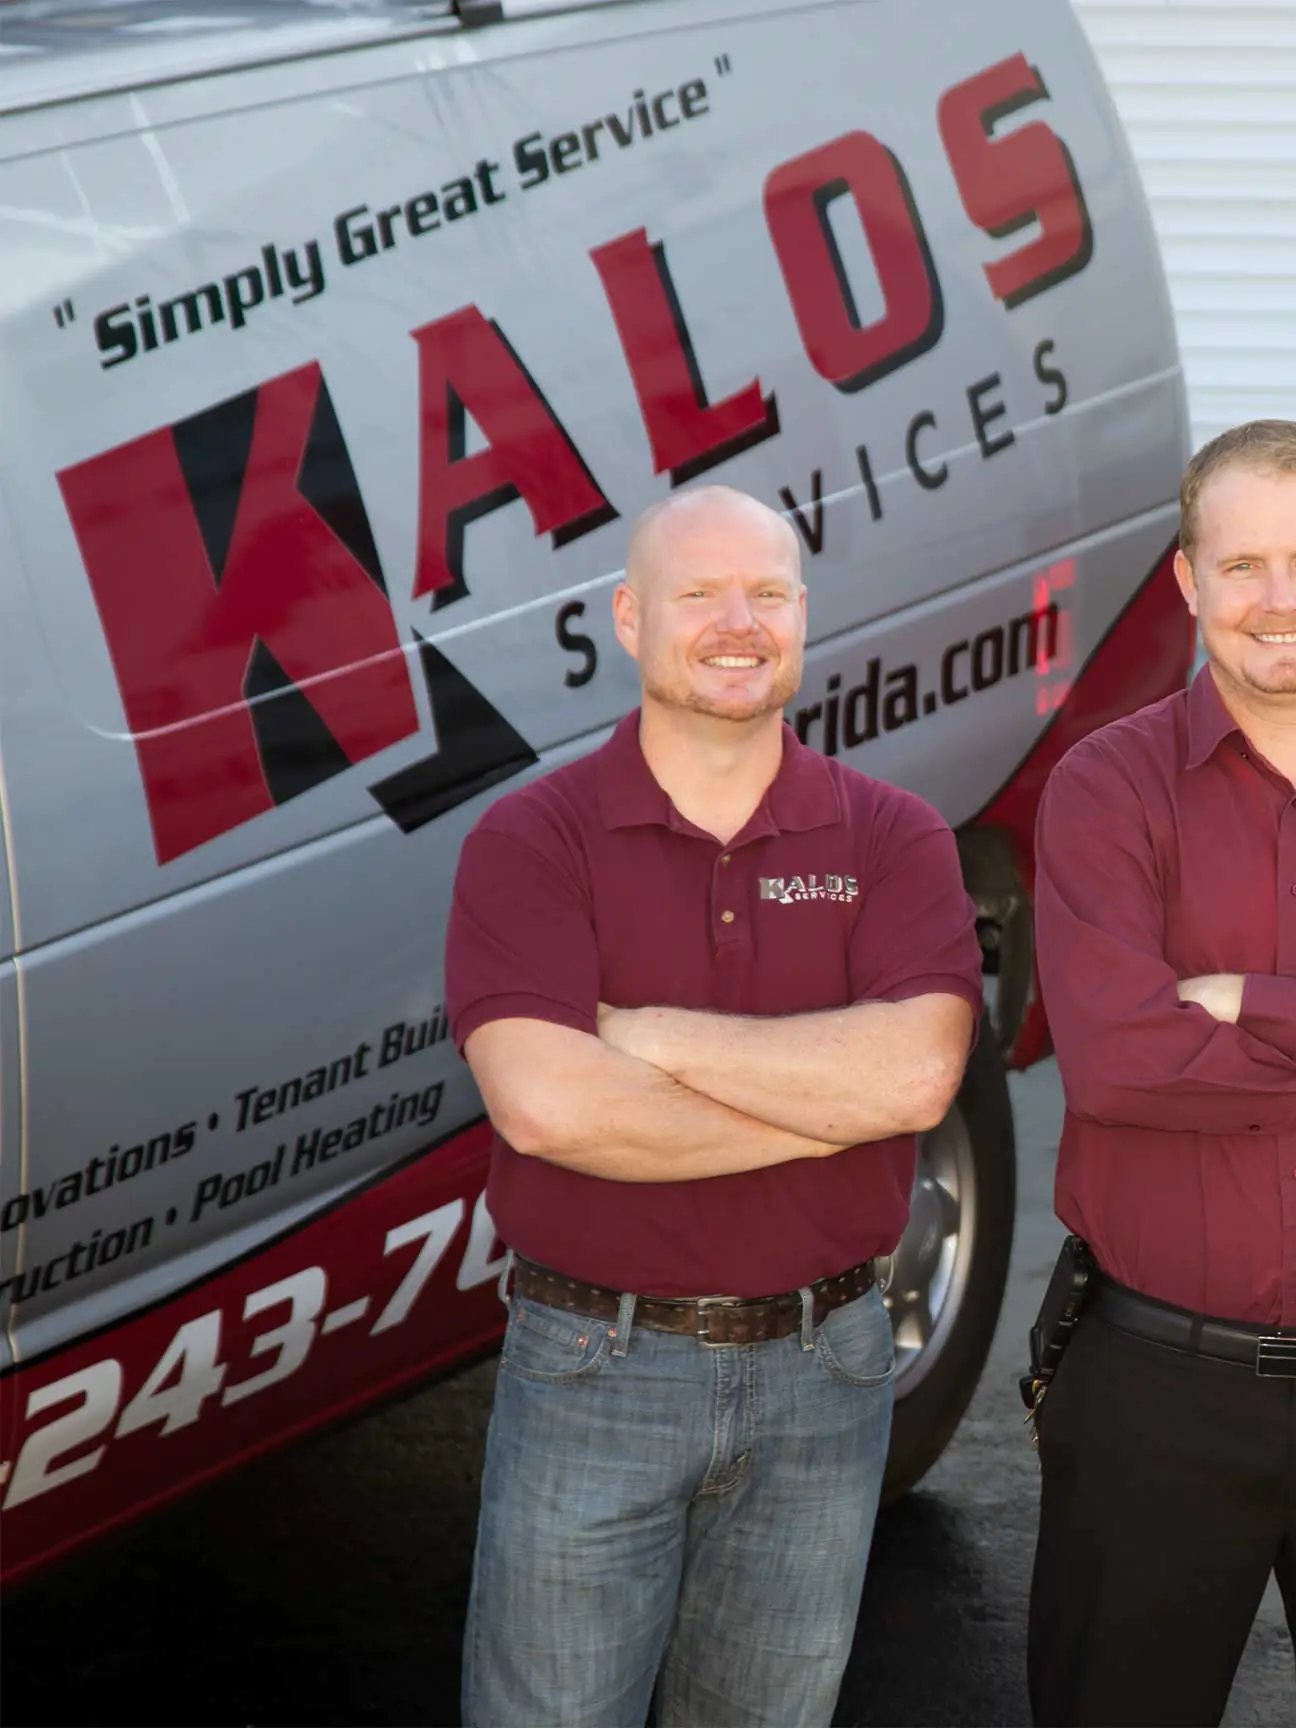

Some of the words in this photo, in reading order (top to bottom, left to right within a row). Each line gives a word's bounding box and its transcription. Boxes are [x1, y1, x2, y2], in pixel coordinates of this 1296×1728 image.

[334, 158, 506, 267] Great
[56, 51, 1093, 865] KALOS
[555, 339, 1068, 689] SVICES
[783, 601, 1059, 757] rida.com
[759, 874, 859, 904] KALOS
[795, 891, 853, 903] SERVICES
[234, 1041, 371, 1133] Tenant
[378, 1003, 449, 1069] Buil
[189, 1145, 285, 1223] Pool
[291, 1081, 445, 1178] Heating
